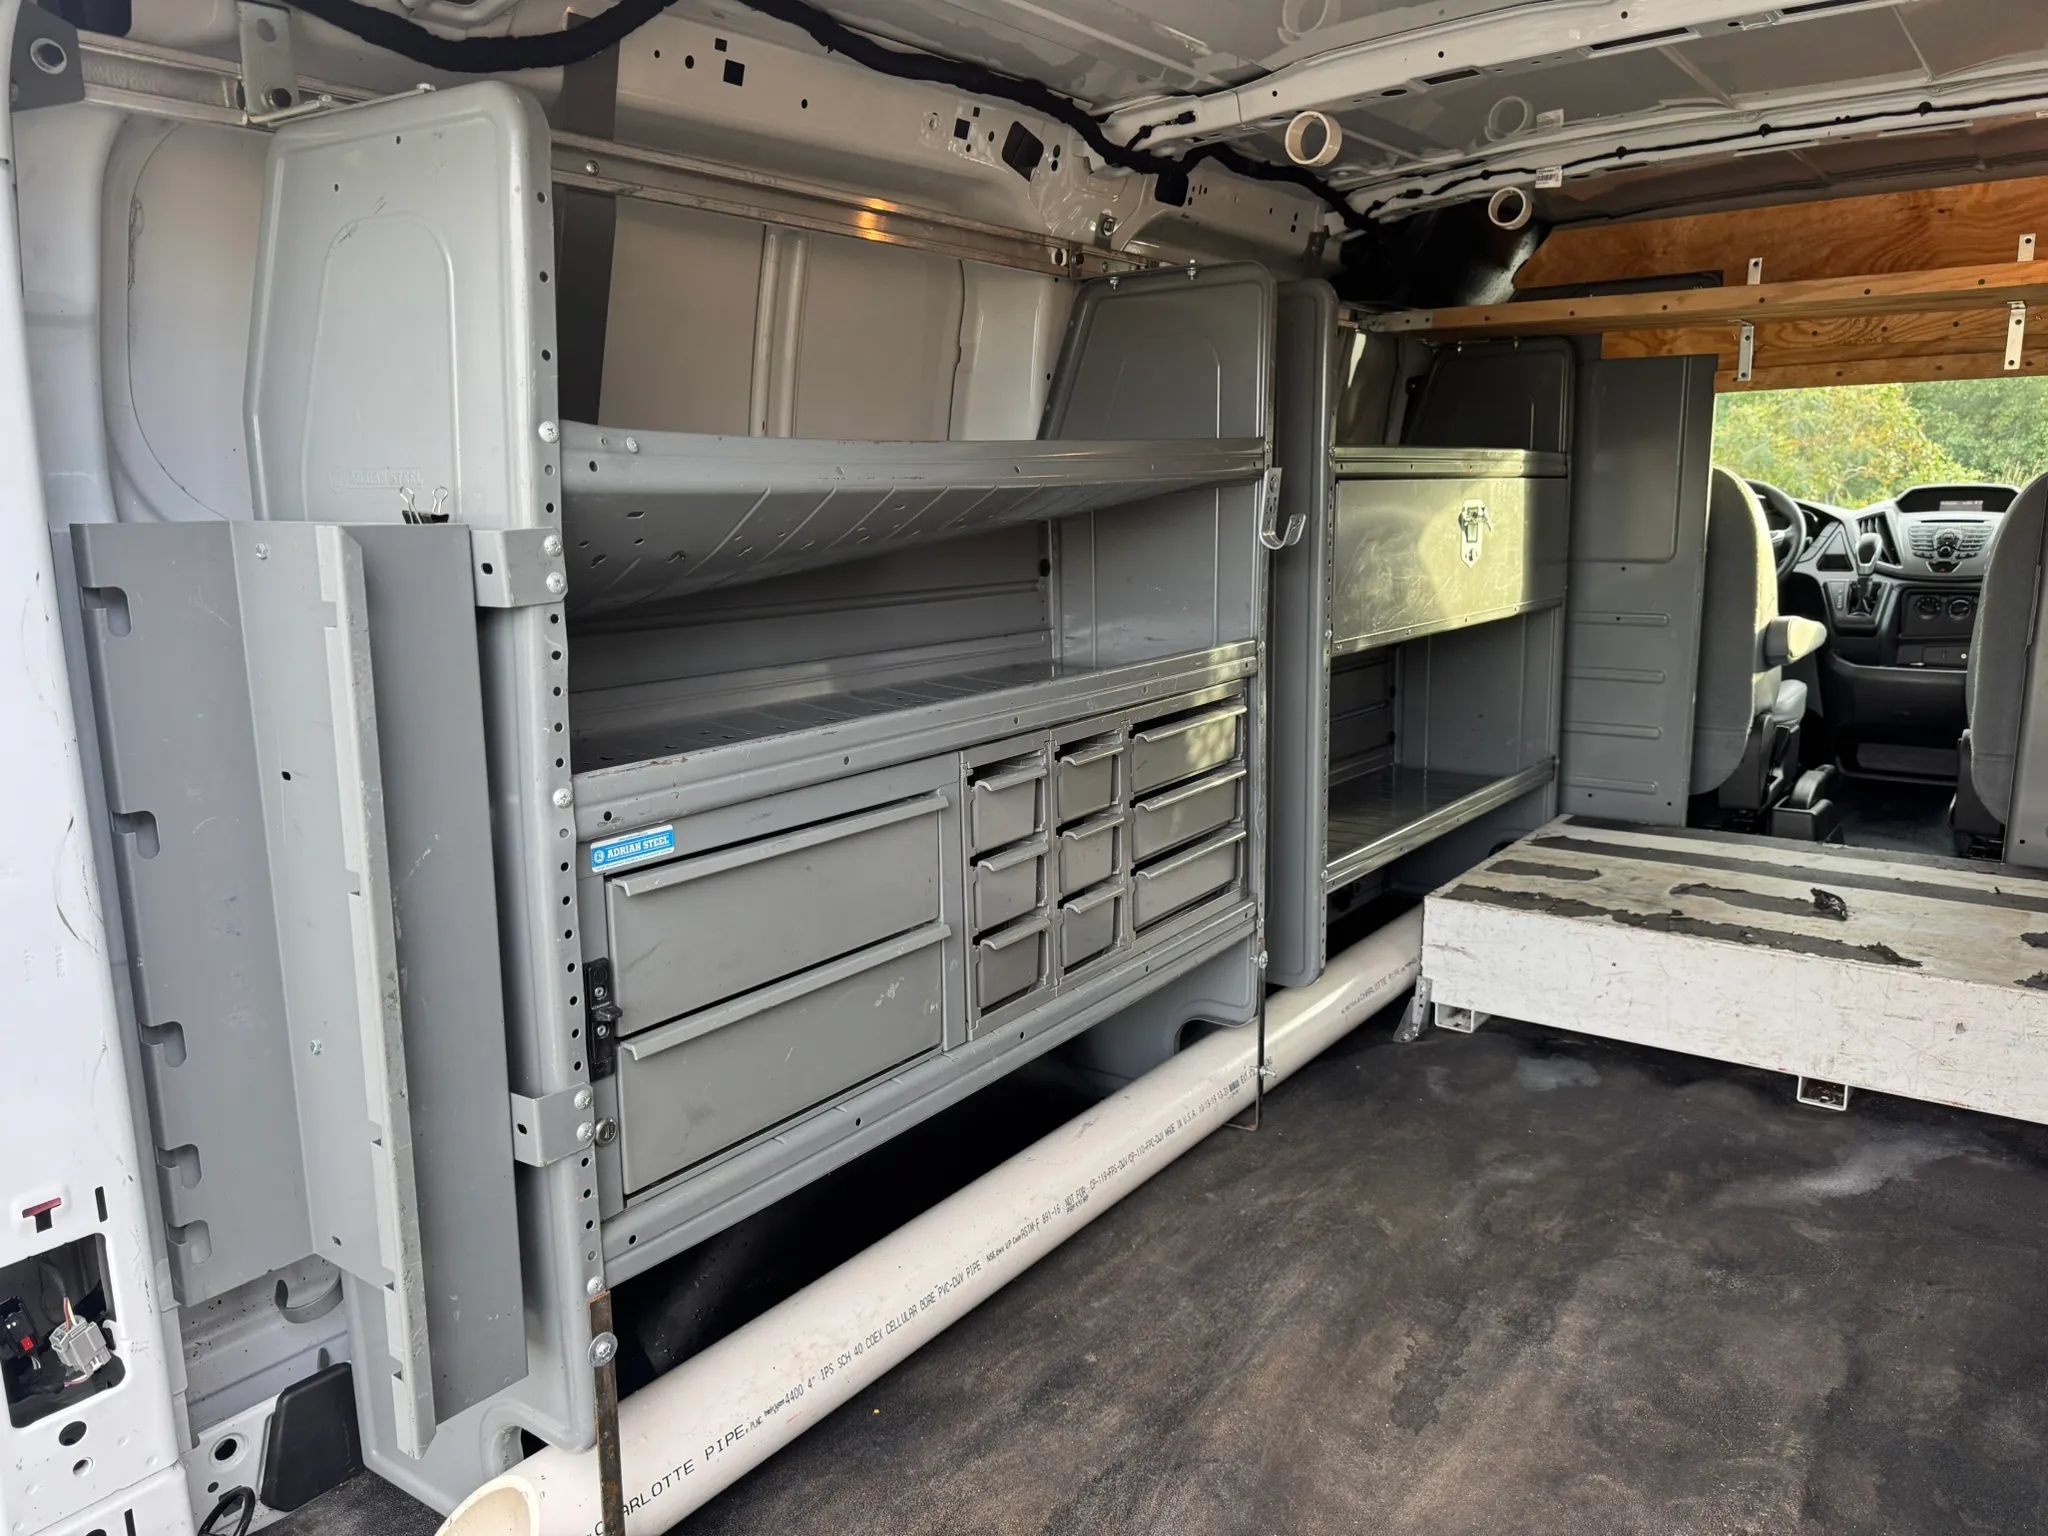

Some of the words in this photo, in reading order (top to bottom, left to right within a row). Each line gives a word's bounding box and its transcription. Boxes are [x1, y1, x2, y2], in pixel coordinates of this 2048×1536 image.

[608, 841, 642, 859] ADRIAN
[643, 835, 670, 850] STEEL
[594, 1458, 696, 1536] CARLOTTE
[704, 1423, 744, 1461] PIPE
[820, 1362, 835, 1381] IPS
[837, 1350, 852, 1369] SCH
[854, 1342, 864, 1357] 40
[865, 1328, 883, 1350] COEX
[885, 1304, 918, 1335] CELLULAR
[965, 1259, 983, 1278] PIPE
